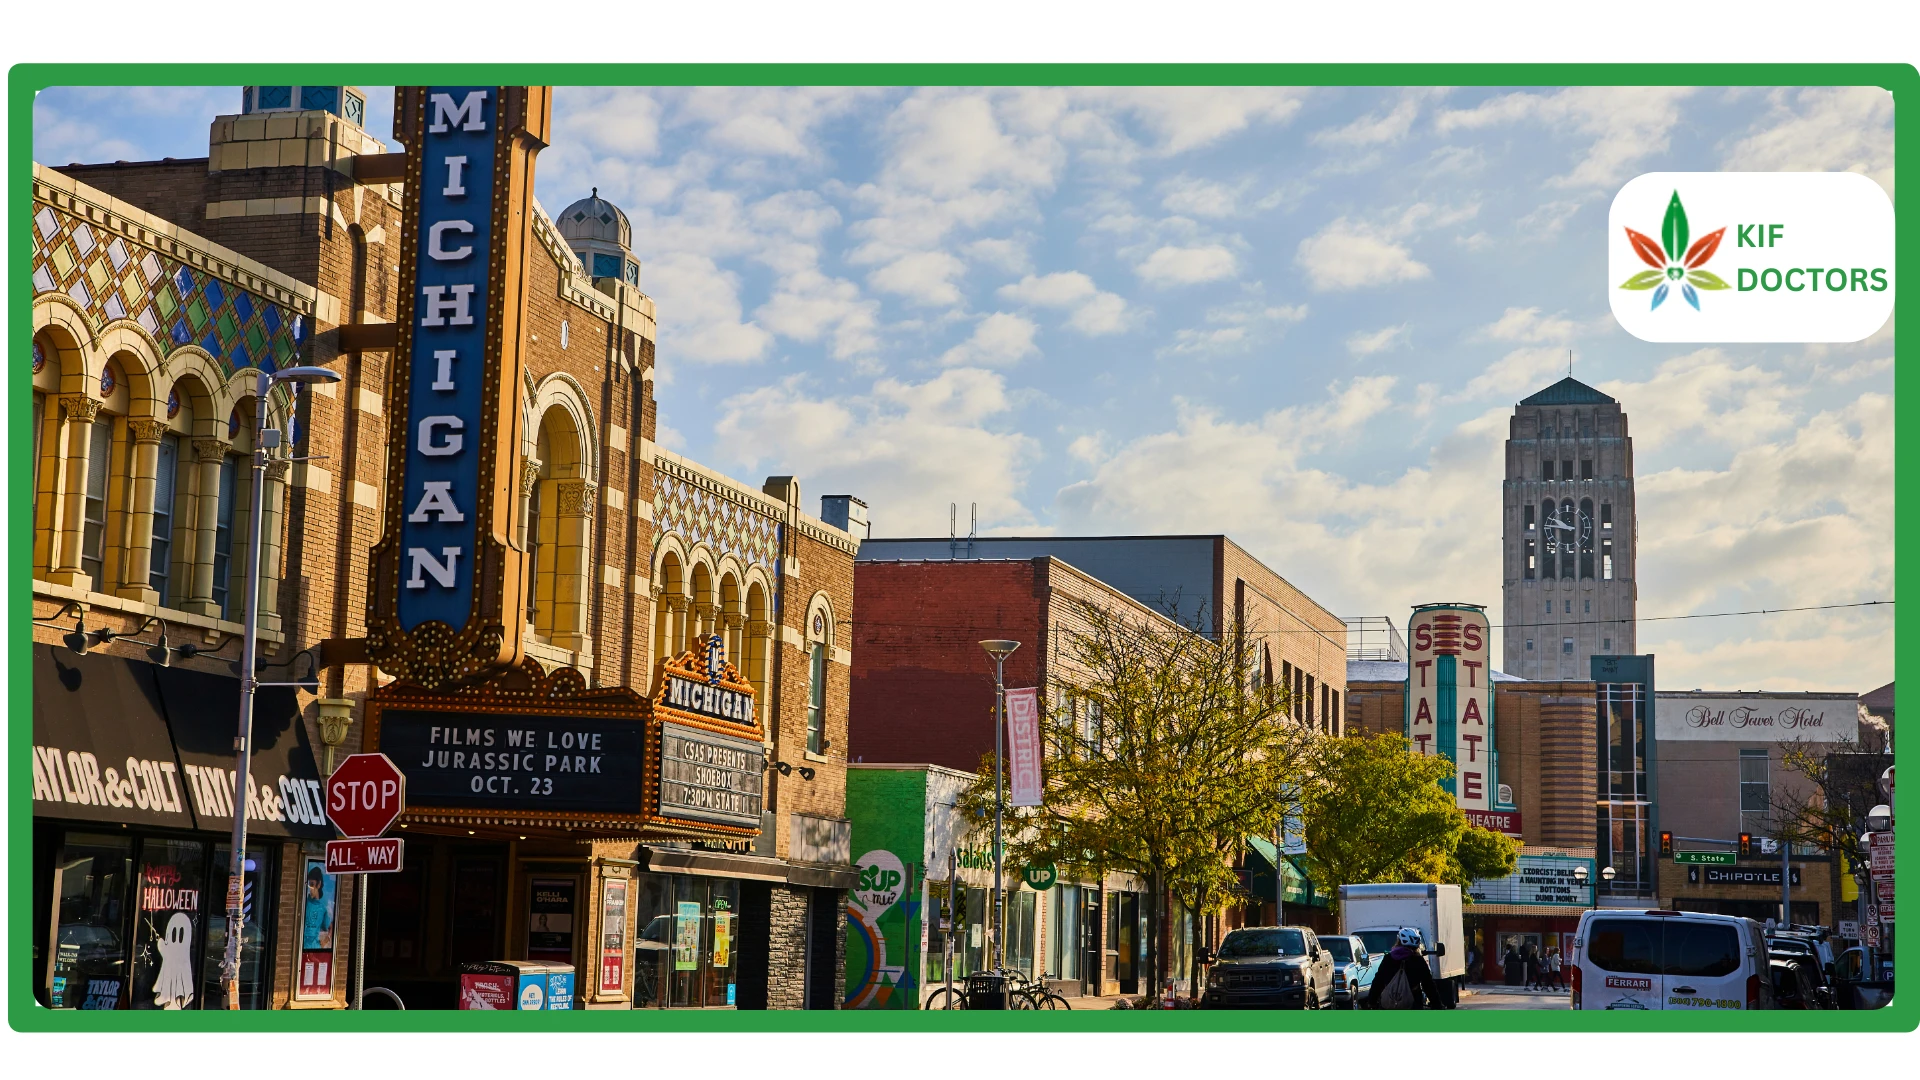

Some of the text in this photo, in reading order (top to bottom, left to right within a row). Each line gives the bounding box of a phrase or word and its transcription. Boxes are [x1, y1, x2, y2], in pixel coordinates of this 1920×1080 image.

[406, 90, 487, 589] MICHIGAN
[670, 677, 754, 723] MICHIGAN
[1461, 623, 1484, 800] STATE
[1685, 705, 1824, 730] Bell Tower Hotel
[430, 726, 602, 750] FILMS WE LOVE
[422, 751, 601, 774] JURASSIC PARK
[684, 742, 746, 769] CSAS PRESENTS
[33, 745, 183, 813] AYLOR&COLT
[470, 775, 554, 796] OCT. 23
[696, 767, 732, 789] SHOEBOX
[331, 779, 397, 812] STOP
[715, 793, 739, 812] STATE
[329, 846, 396, 867] ALL WAY
[1690, 854, 1725, 862] S. State
[1030, 870, 1051, 883] UP
[1708, 870, 1780, 882] CHIPOTLE
[142, 887, 199, 911] HALLOWEEN
[1535, 894, 1578, 903] DUMB MONEY
[1540, 886, 1571, 894] BOTTOMS
[714, 899, 728, 909] OPEN
[87, 979, 121, 997] TAYLOR
[1608, 978, 1649, 988] FERRARI
[1691, 997, 1741, 1009] 790-1800
